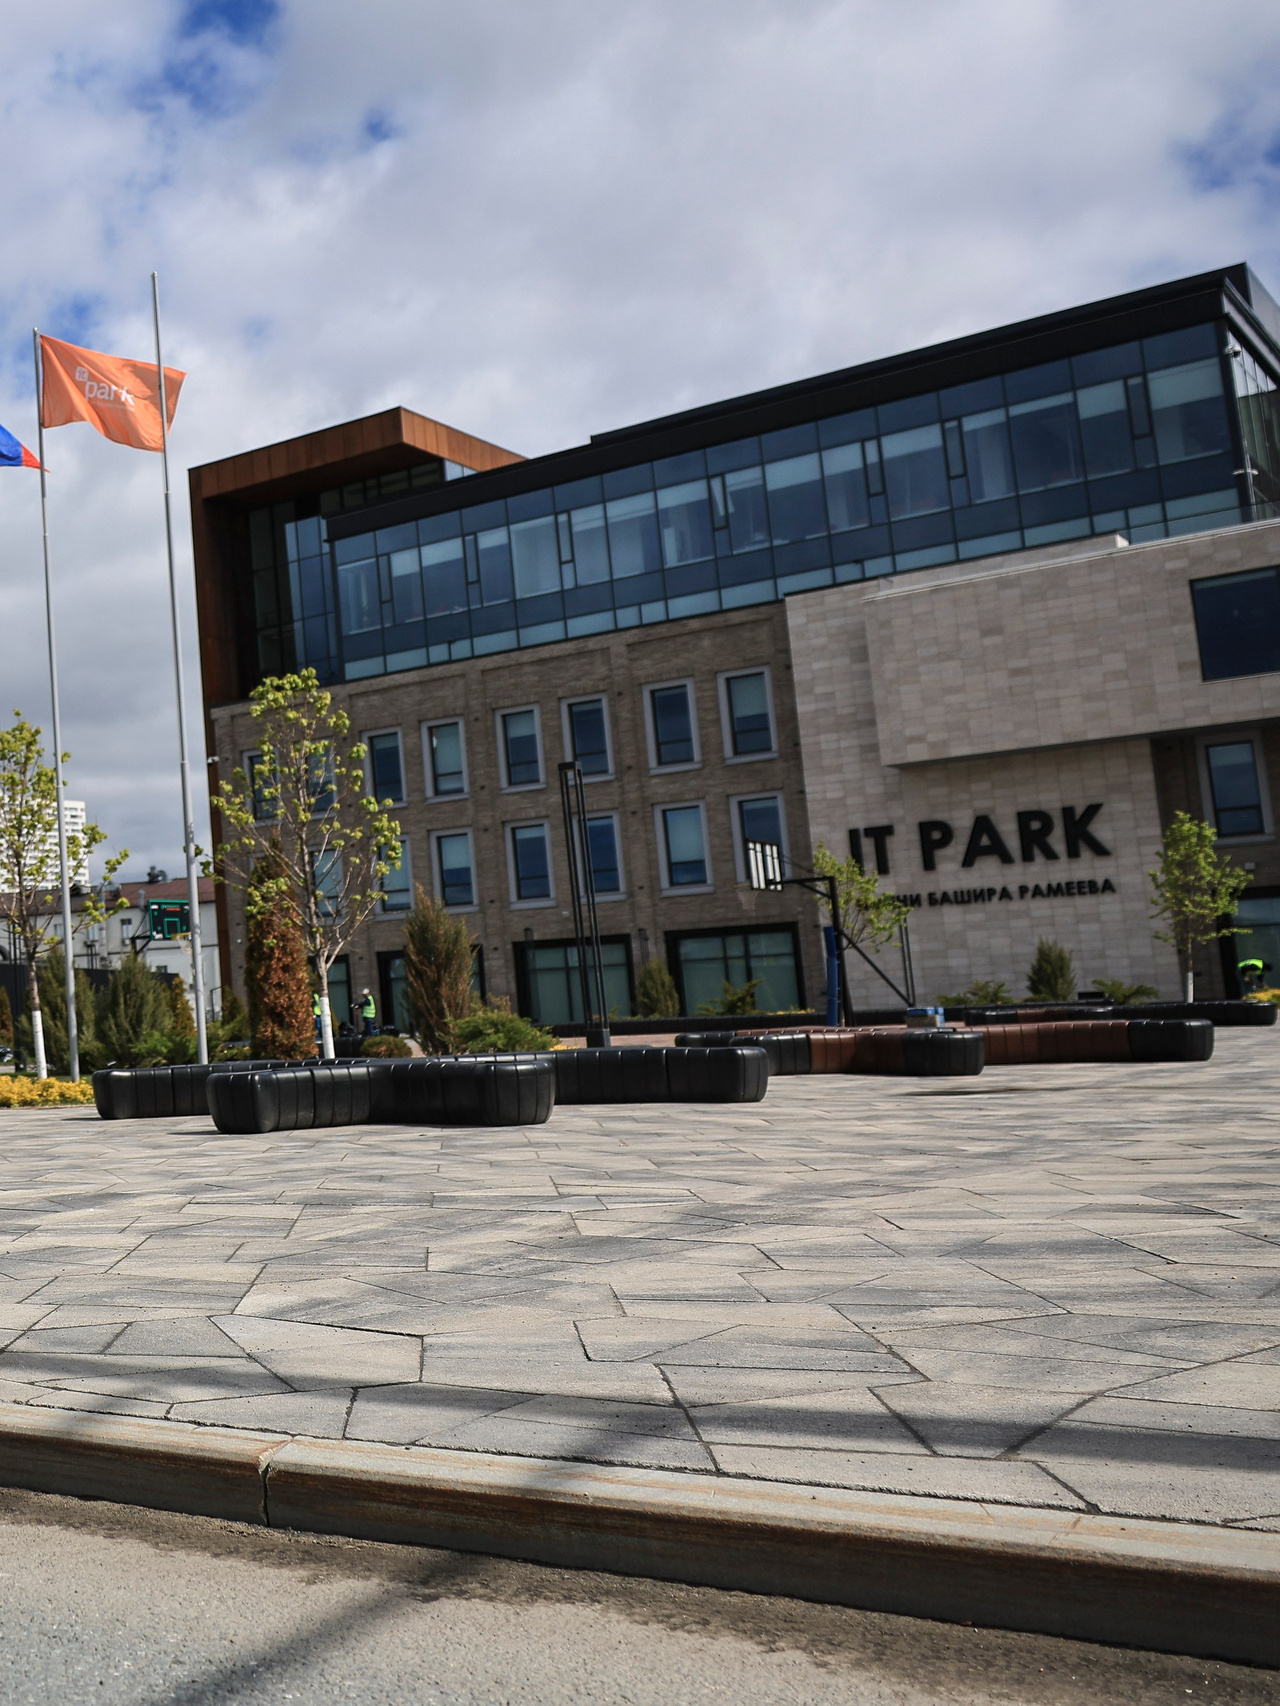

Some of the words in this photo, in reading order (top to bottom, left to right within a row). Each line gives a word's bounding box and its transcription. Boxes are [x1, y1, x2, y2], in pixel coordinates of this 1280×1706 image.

[86, 381, 135, 405] park
[848, 824, 895, 876] IT
[918, 803, 1111, 871] PARK
[928, 886, 1013, 907] БАШИРА
[1018, 878, 1116, 900] РАМЕЕВА
